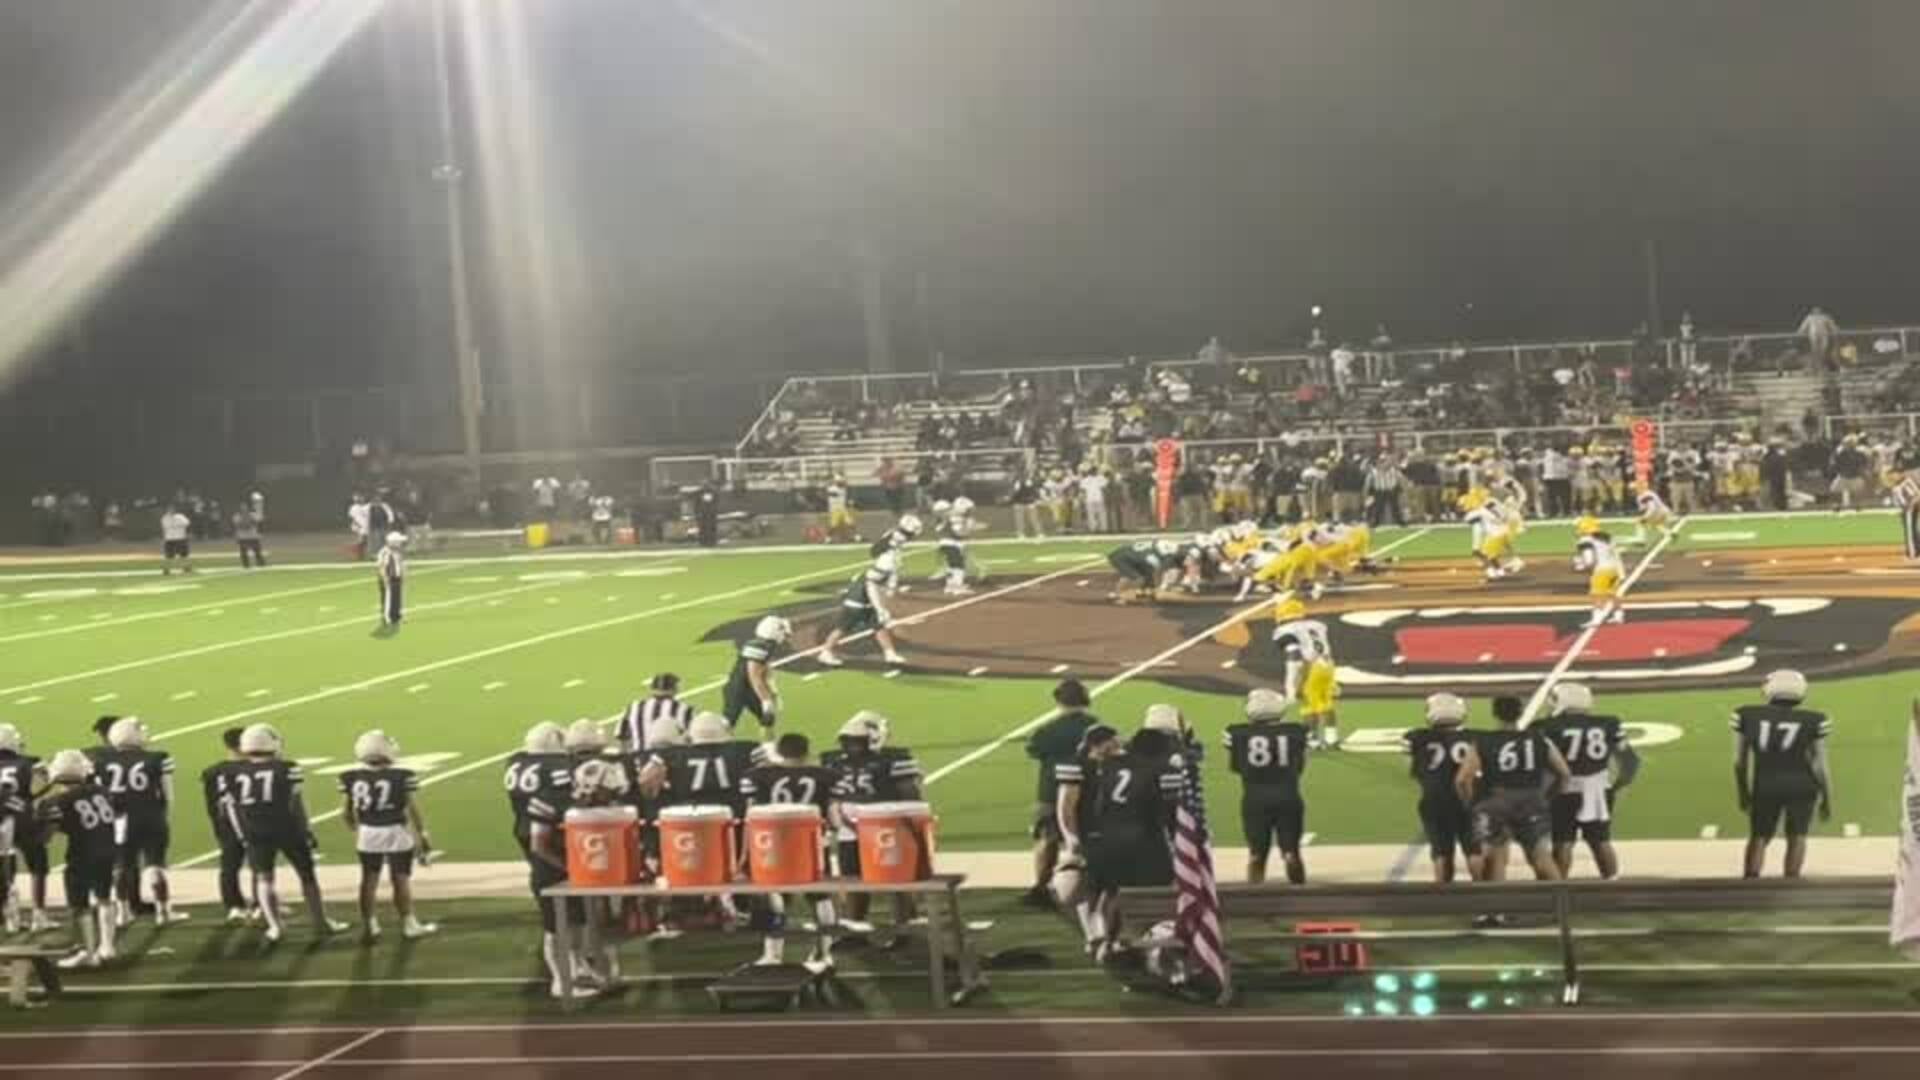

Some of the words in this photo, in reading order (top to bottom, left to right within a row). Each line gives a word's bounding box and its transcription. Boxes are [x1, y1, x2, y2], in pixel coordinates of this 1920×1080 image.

[1248, 735, 1289, 767] 81
[1562, 727, 1608, 761] 78
[1759, 720, 1801, 751] 17
[1498, 739, 1535, 771] 61
[106, 761, 149, 793] 26
[235, 770, 275, 805] 27
[504, 762, 543, 792] 66
[688, 757, 730, 791] 71
[352, 779, 395, 811] 82
[74, 794, 115, 829] 88
